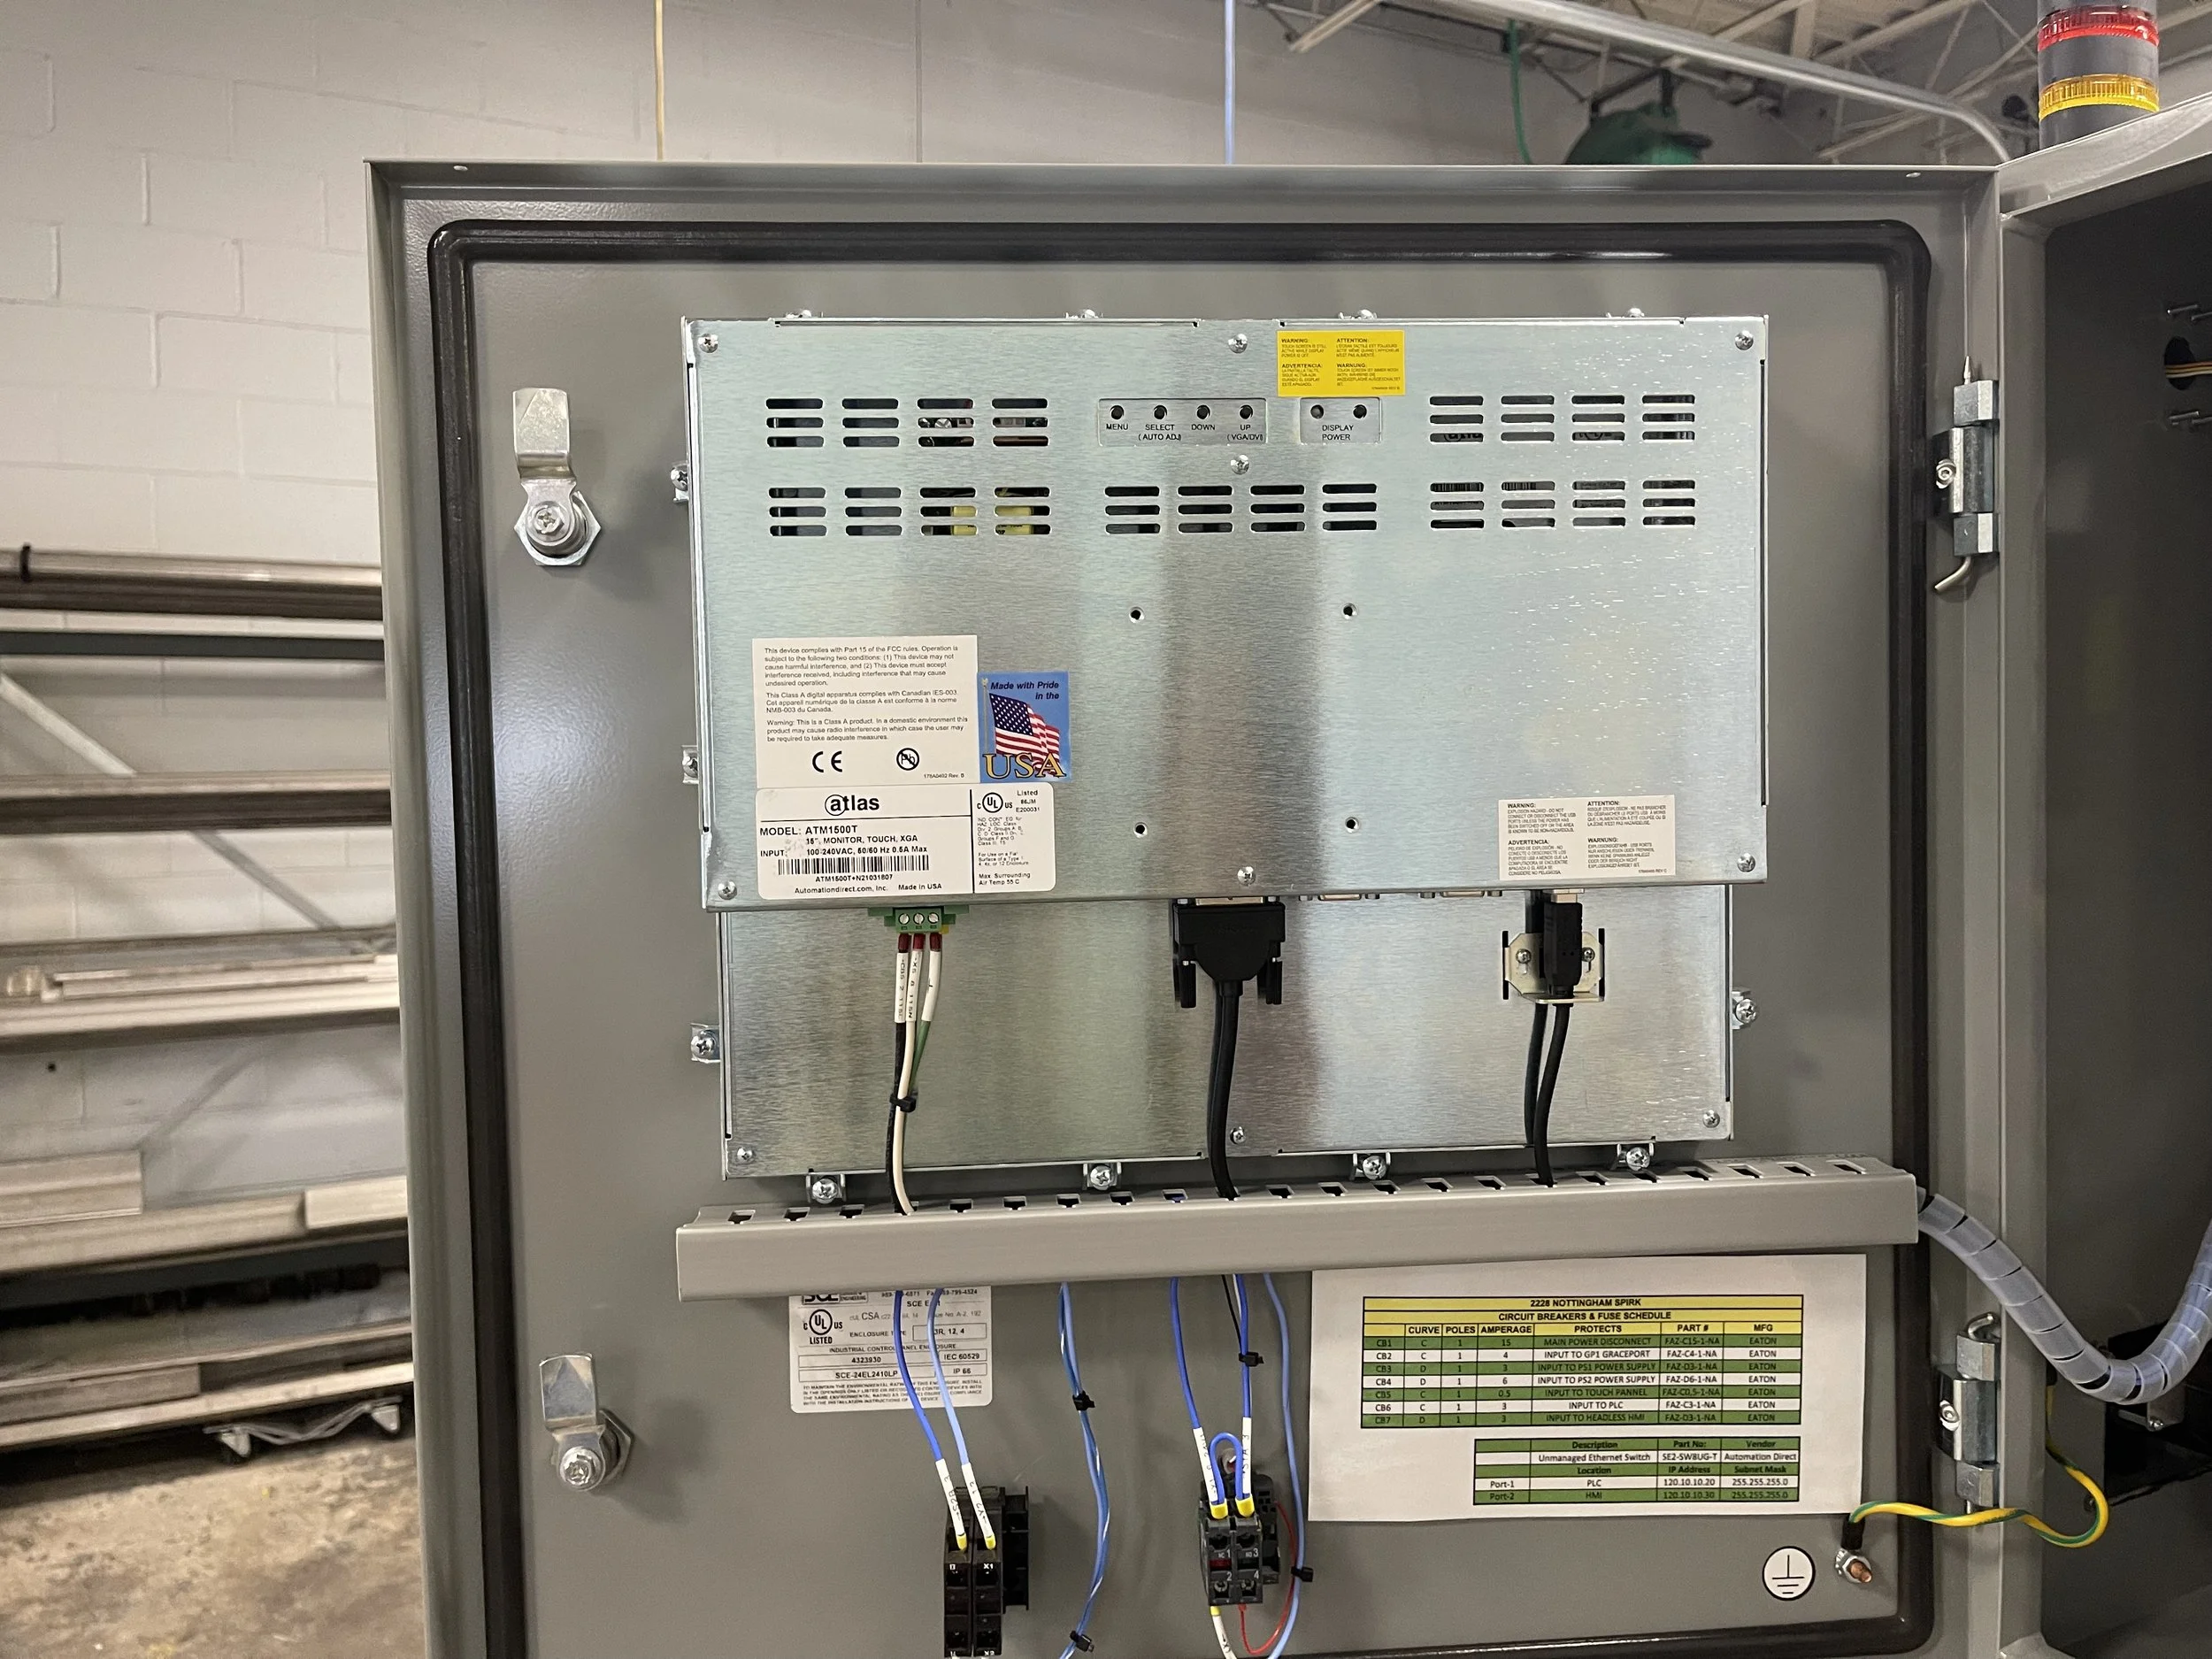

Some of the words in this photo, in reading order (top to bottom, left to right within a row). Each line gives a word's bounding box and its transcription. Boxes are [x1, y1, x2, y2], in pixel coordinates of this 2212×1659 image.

[982, 752, 1066, 779] USA
[830, 795, 879, 811] atlas
[805, 826, 857, 834] ATM1500T
[1539, 1454, 1586, 1463] Unmanaged
[1254, 1548, 1258, 1557] 3
[1227, 1571, 1232, 1581] 2
